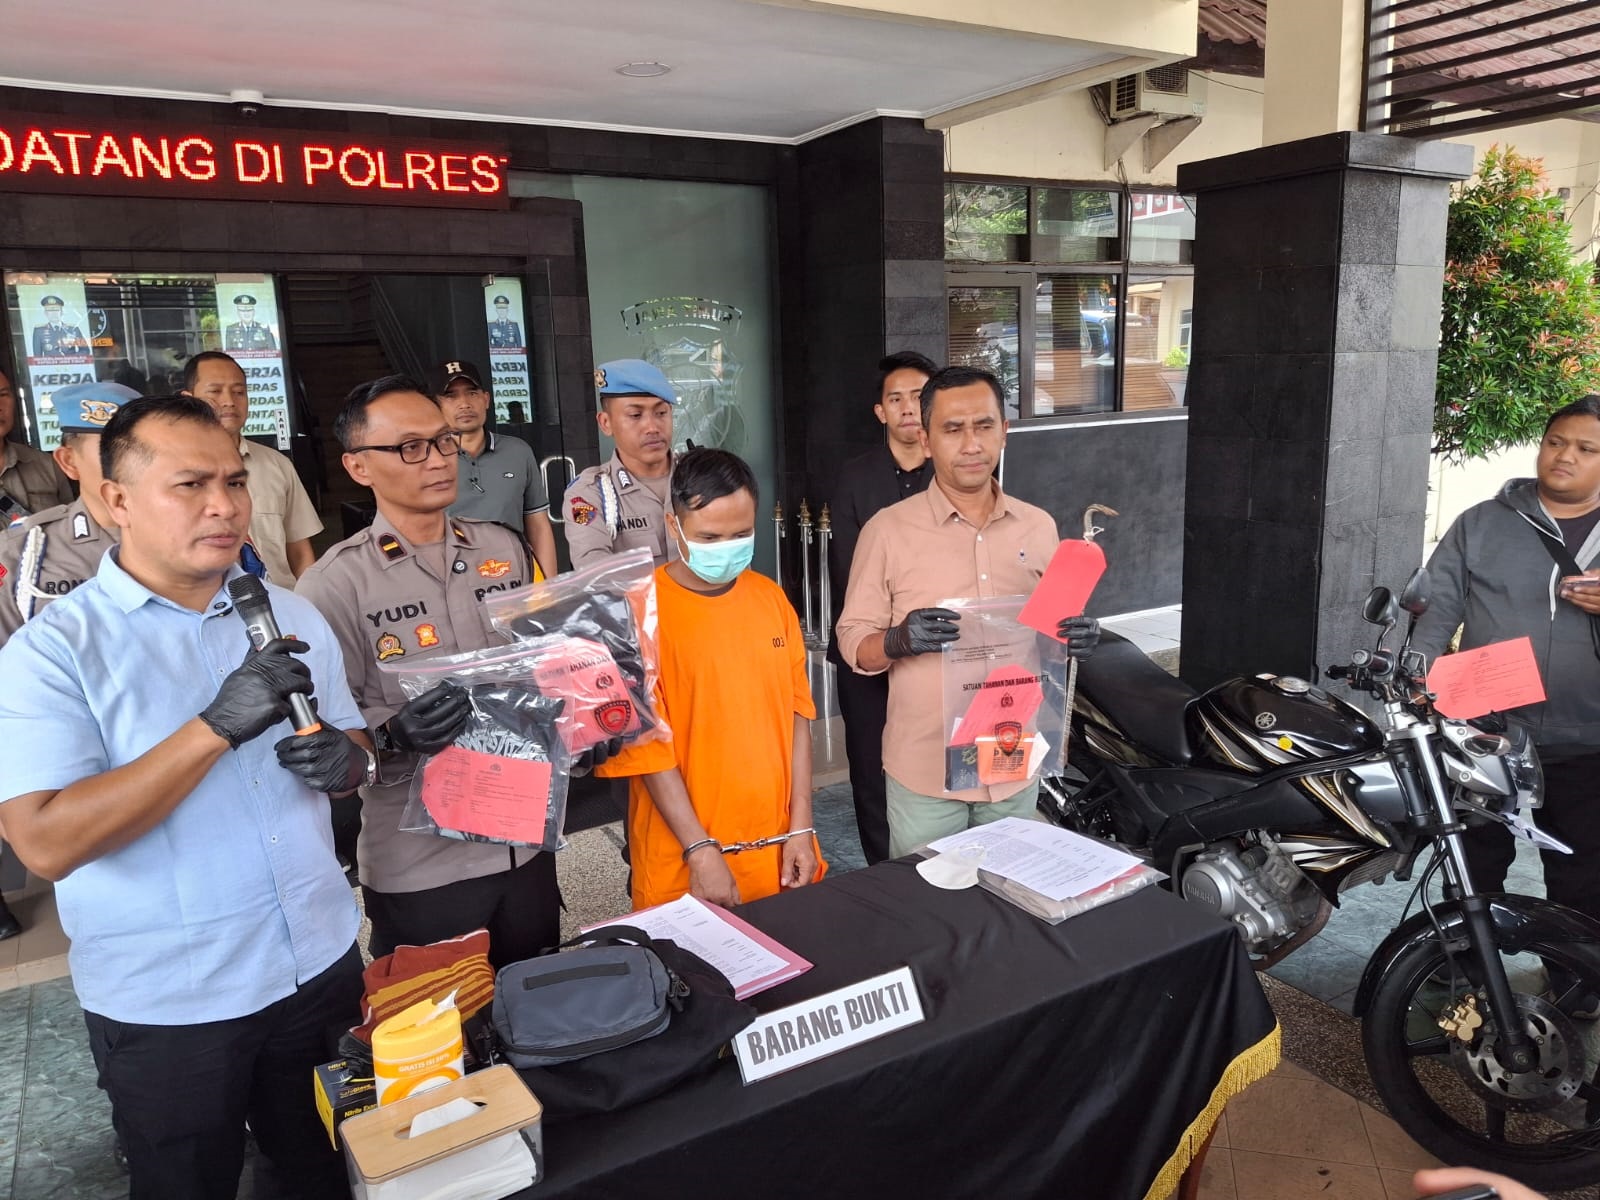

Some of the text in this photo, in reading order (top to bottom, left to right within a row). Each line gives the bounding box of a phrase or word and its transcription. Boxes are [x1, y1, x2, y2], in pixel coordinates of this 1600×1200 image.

[234, 142, 284, 184] DI
[303, 146, 508, 193] POLRES
[445, 362, 463, 374] H
[33, 373, 93, 386] KERJA
[367, 601, 428, 628] YUDI
[963, 682, 982, 692] SATUAN
[746, 981, 910, 1066] BARANG BUKTI
